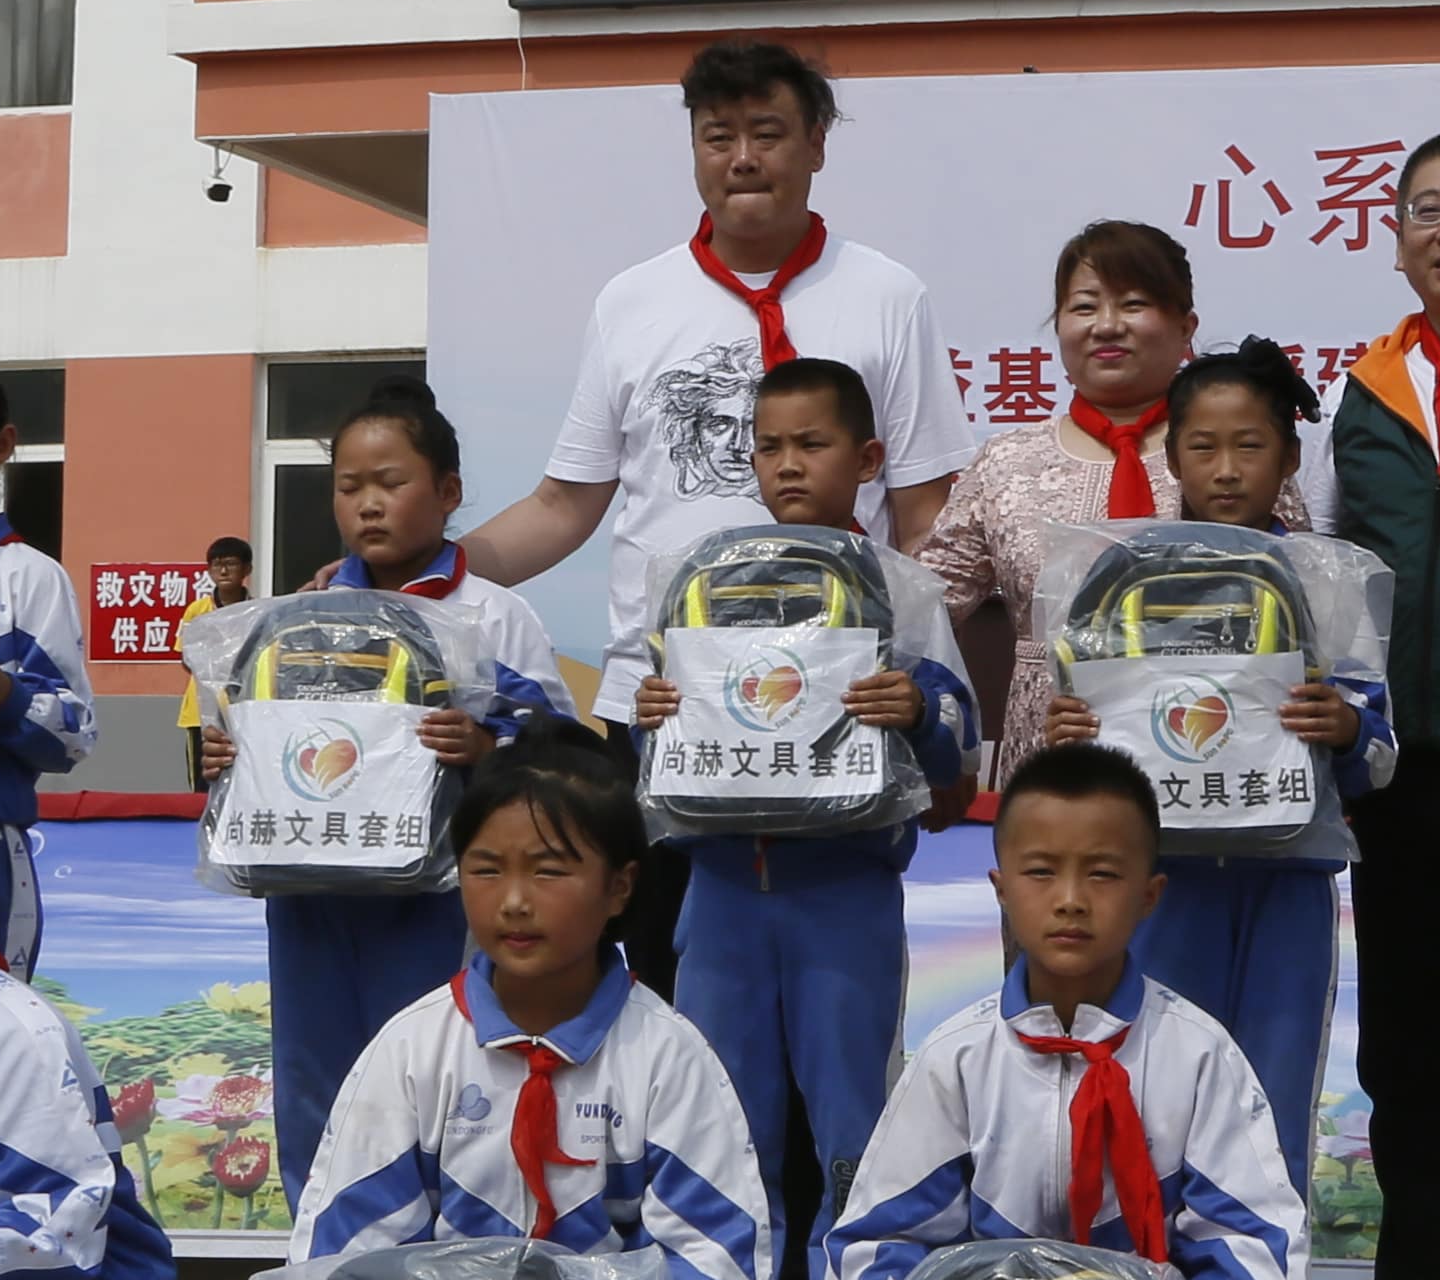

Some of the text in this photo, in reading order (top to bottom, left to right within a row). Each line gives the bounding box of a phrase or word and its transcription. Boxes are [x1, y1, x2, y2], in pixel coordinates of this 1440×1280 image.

[111, 617, 182, 654] 供应
[222, 809, 426, 849] 尚赫文具套组
